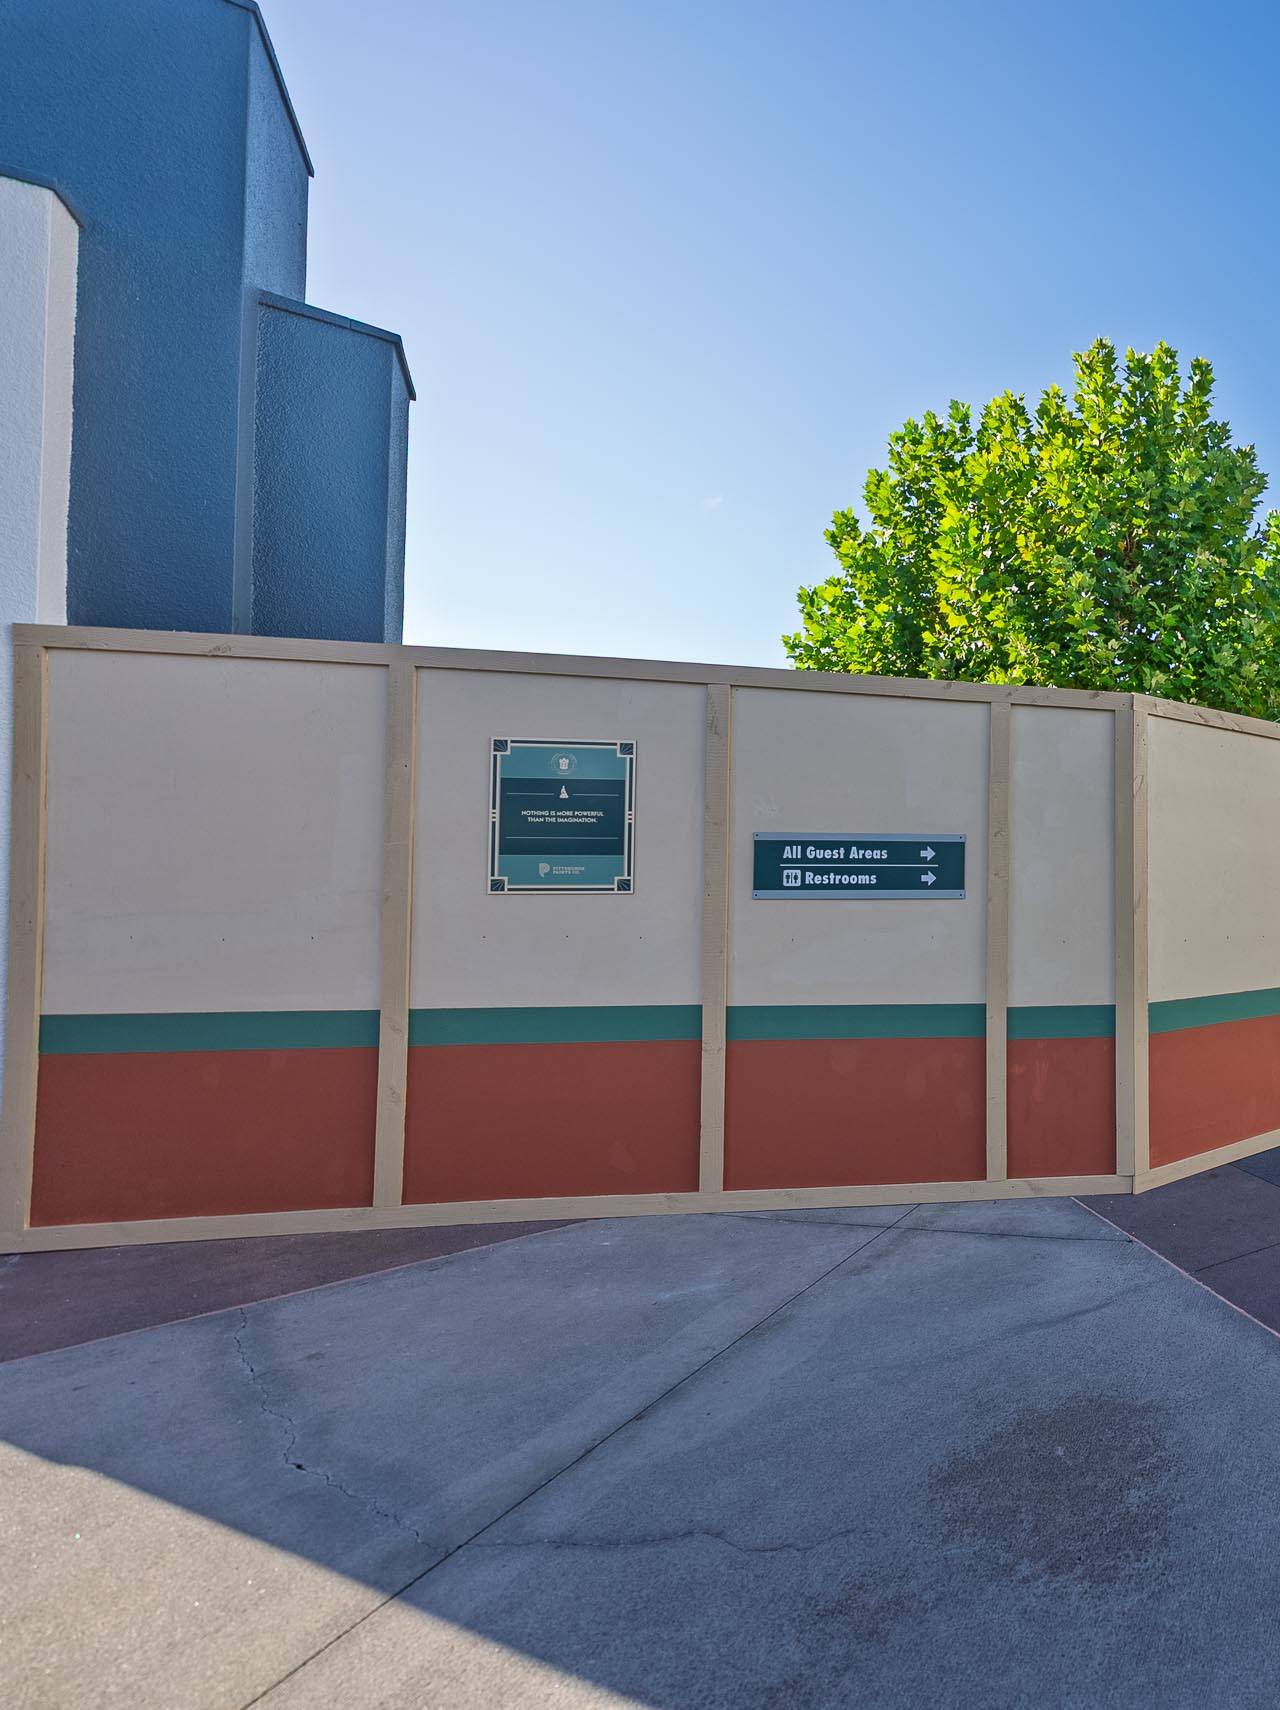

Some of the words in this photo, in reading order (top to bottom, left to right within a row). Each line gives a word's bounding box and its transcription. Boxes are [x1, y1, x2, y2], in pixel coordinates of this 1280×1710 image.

[782, 845, 801, 859] All
[806, 846, 845, 859] Guest
[849, 846, 888, 859] Areas
[805, 871, 877, 885] Restrooms
